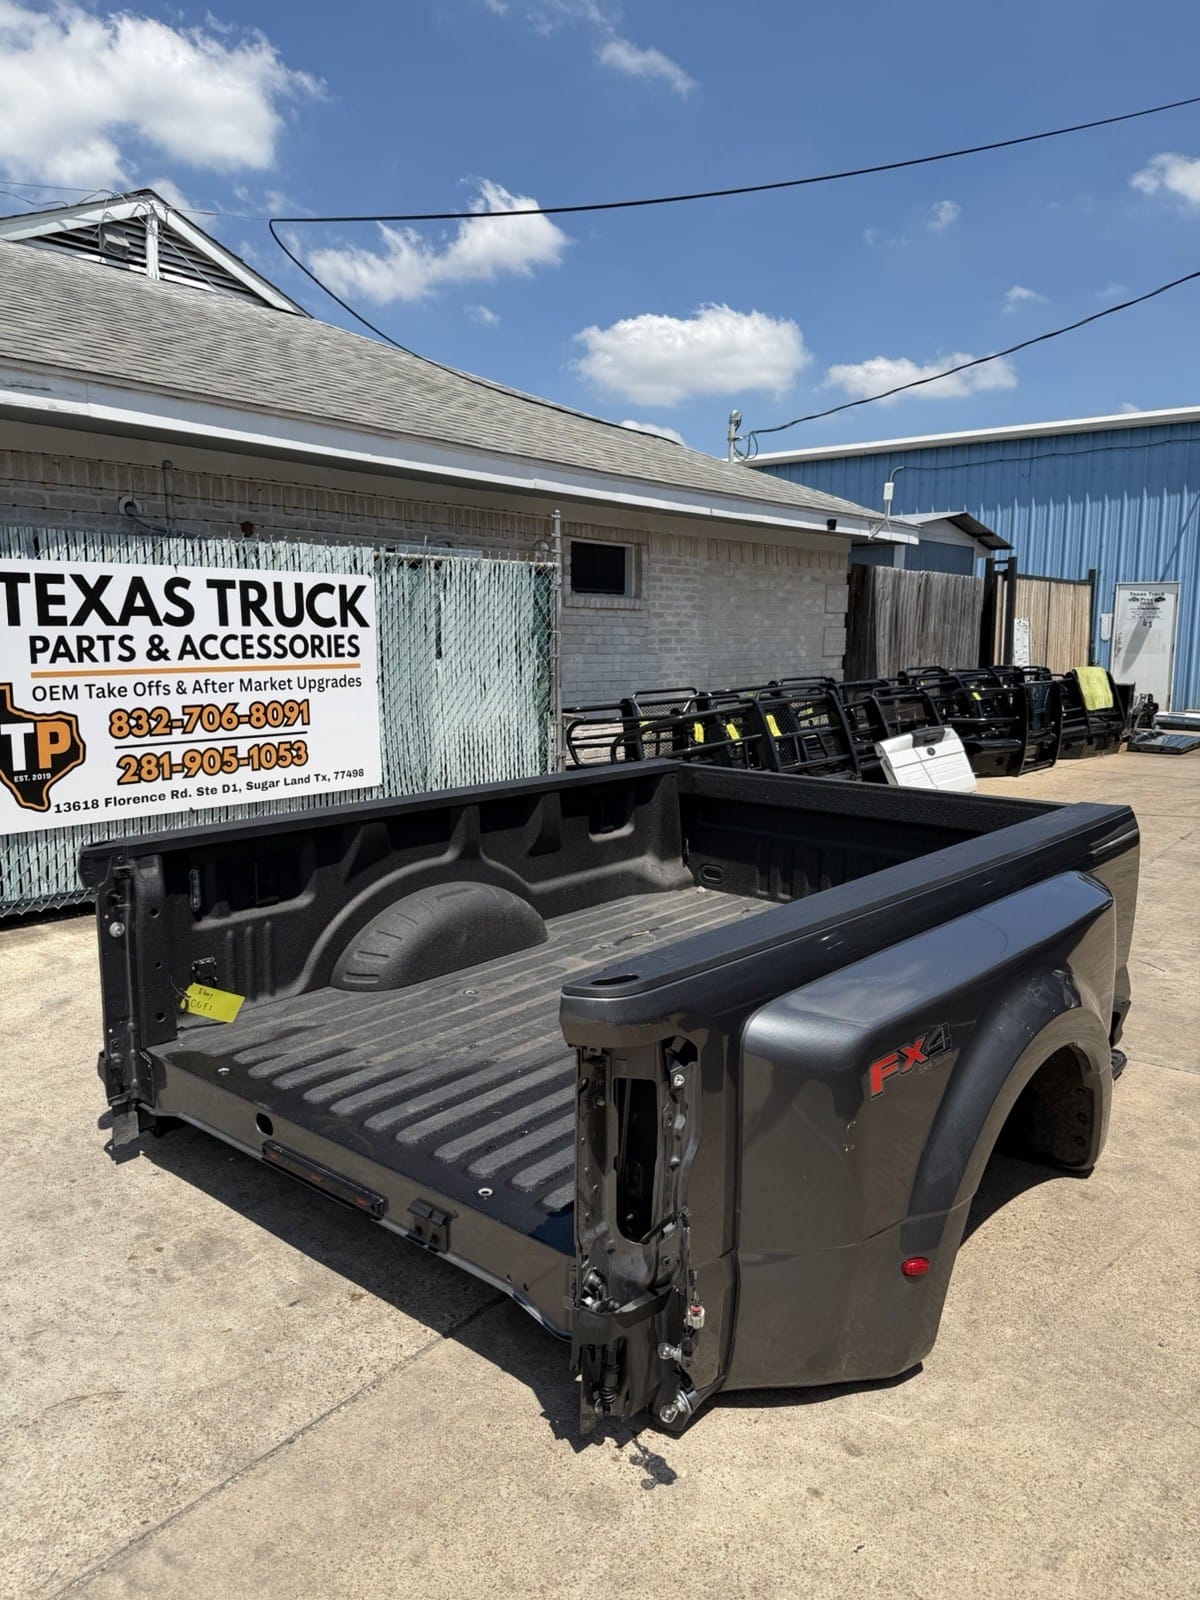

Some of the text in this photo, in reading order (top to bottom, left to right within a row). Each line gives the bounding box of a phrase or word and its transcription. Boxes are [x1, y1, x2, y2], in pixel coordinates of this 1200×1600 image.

[0, 572, 370, 628] TEXAS TRUCK
[29, 633, 361, 664] PARTS & ACCESSORIES
[32, 674, 362, 702] OEM Take Offs & After Market Upgrades
[109, 698, 311, 740] 832-706-8091
[14, 772, 52, 783] EST. 2019
[116, 740, 309, 786] 281-905-1053
[54, 768, 364, 814] 13618 Florence Rd. Ste D1, Sugar Land Tx, 77498
[869, 1022, 952, 1100] FX4
